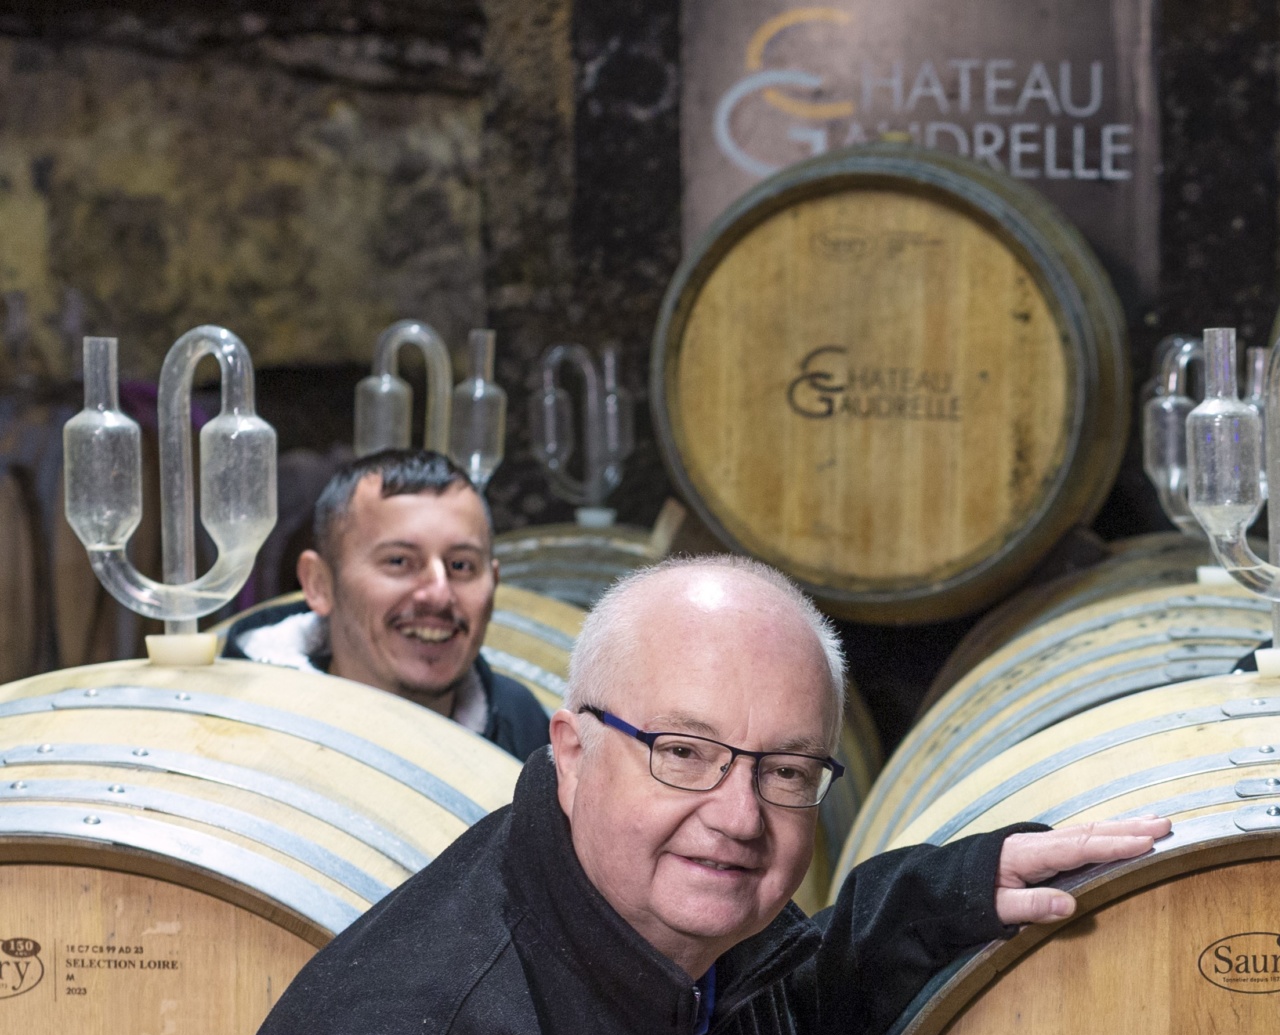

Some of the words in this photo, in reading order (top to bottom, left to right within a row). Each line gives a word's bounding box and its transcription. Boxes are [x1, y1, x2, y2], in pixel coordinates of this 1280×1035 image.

[713, 69, 1133, 179] GDRELLE
[10, 940, 34, 951] 150
[66, 959, 136, 969] SELECTION
[139, 960, 179, 970] LOIRE
[66, 987, 87, 996] 2023
